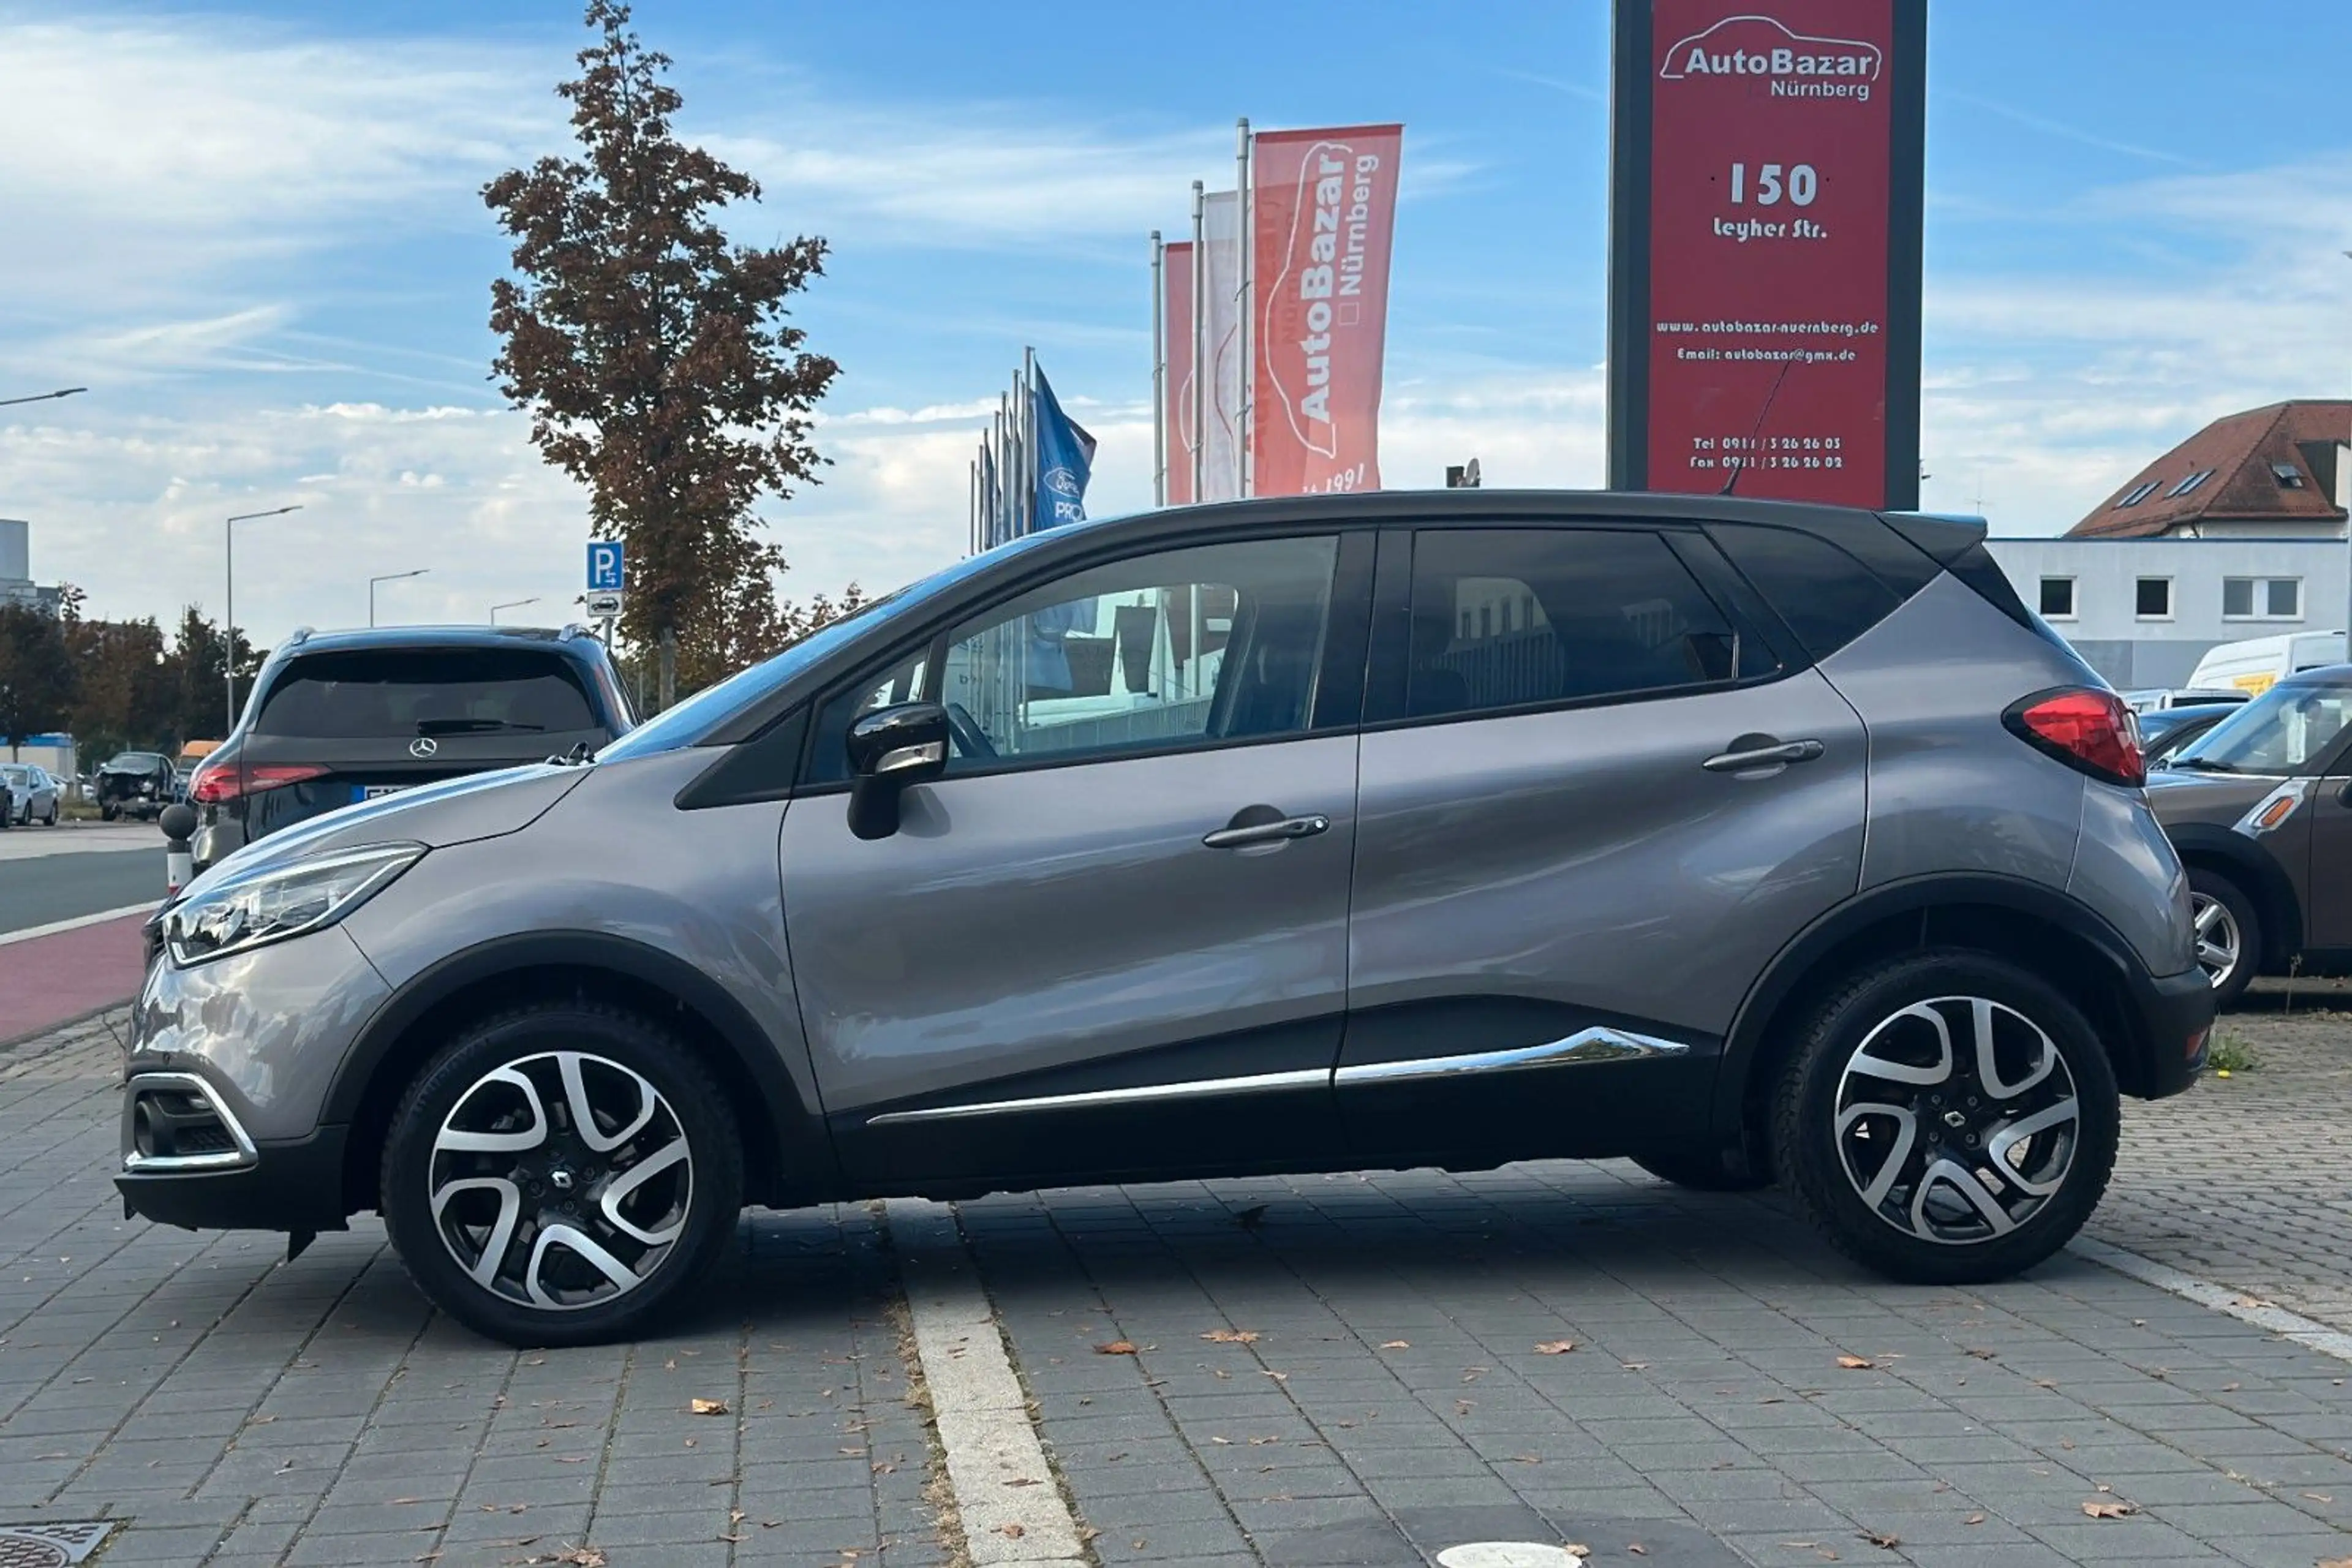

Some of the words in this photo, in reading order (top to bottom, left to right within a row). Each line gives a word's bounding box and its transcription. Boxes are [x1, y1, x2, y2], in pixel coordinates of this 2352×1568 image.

[1684, 47, 1872, 75] AutoBazar
[1771, 80, 1870, 102] Nürnberg
[1731, 162, 1817, 206] 150
[1339, 154, 1379, 296] Nürnberg
[1792, 218, 1828, 239] Str.
[1298, 152, 1344, 424] AutoBazar
[1677, 347, 1721, 360] Email:
[1724, 347, 1856, 364] autobazar@gmx.de
[1693, 437, 1714, 449] Tel
[1722, 437, 1755, 449] 0911
[595, 548, 614, 584] P
